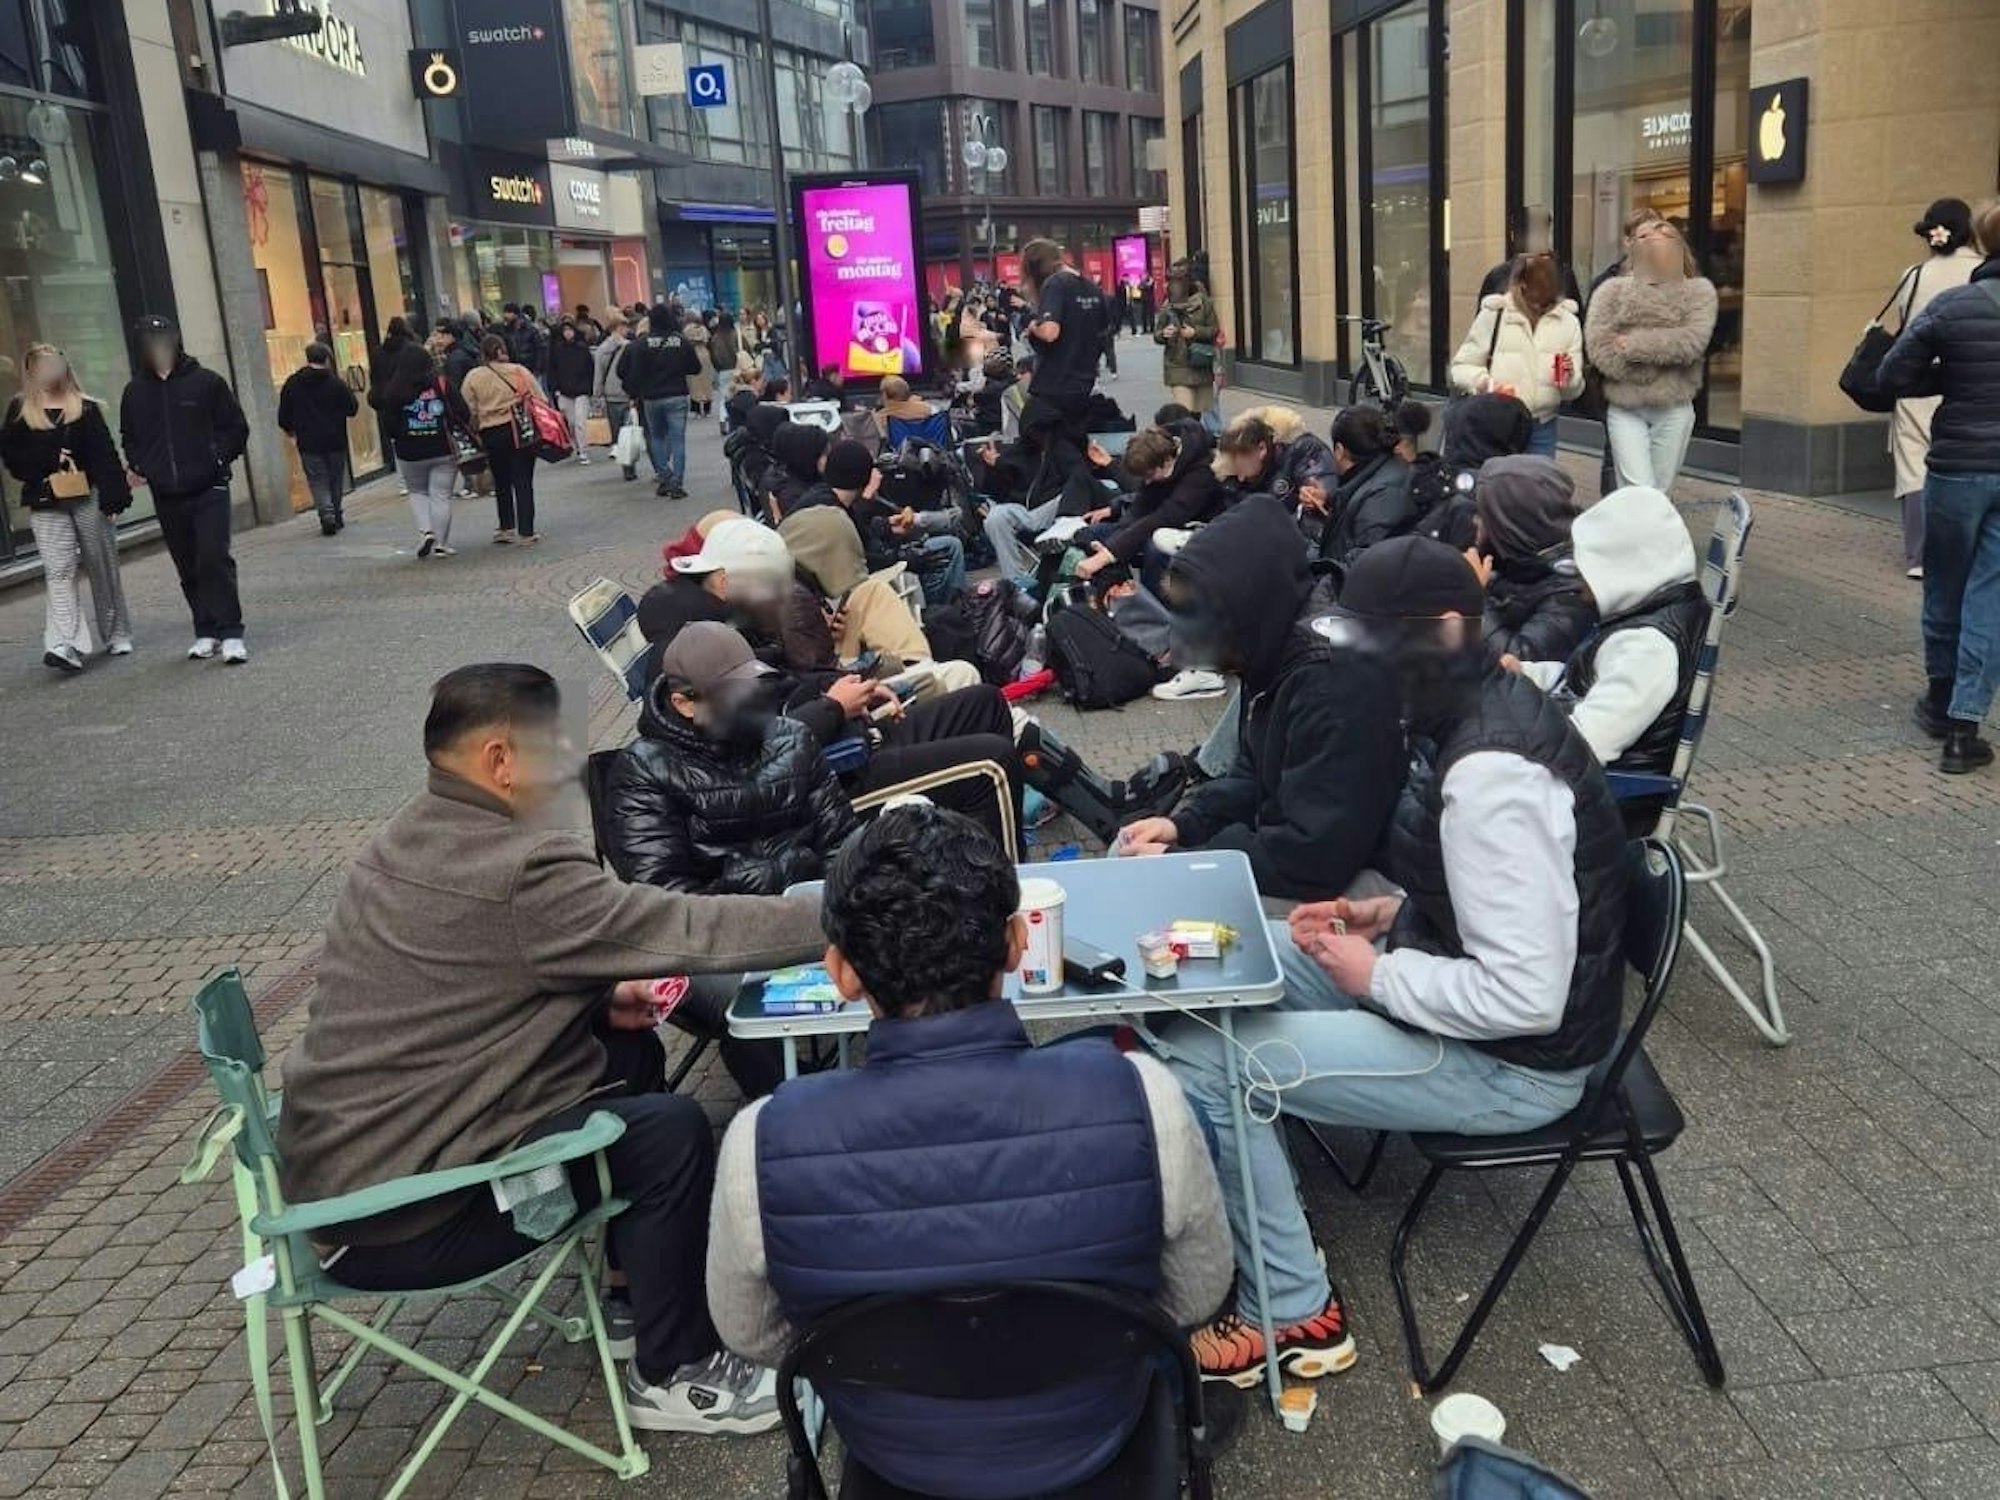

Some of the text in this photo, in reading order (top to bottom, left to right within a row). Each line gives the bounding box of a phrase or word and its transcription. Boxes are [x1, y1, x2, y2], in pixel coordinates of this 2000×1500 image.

[468, 26, 532, 44] swatch
[491, 176, 536, 203] swatch
[820, 216, 875, 232] freitag
[838, 263, 902, 279] montag
